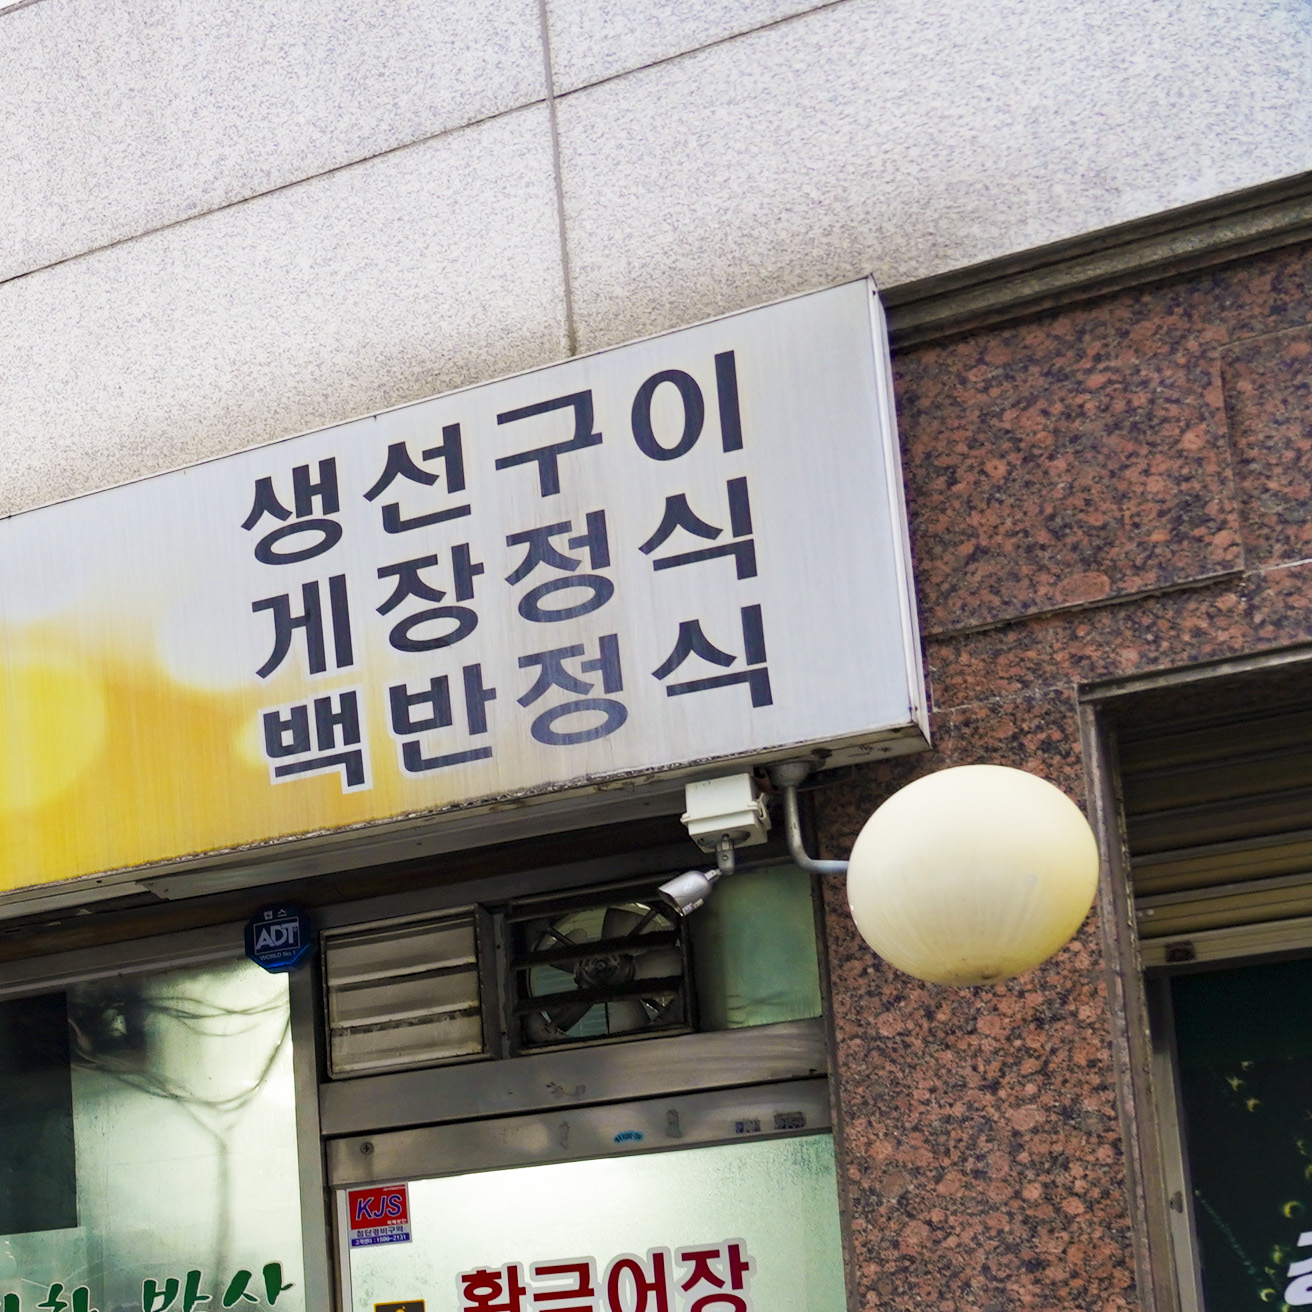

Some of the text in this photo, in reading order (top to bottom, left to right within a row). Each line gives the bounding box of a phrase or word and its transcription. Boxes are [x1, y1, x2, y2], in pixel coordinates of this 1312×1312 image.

[240, 350, 746, 566] 생선구이
[251, 476, 758, 680] 게장정식
[261, 604, 774, 788] 백반정식
[256, 922, 297, 950] ADT
[356, 1193, 403, 1221] KJS
